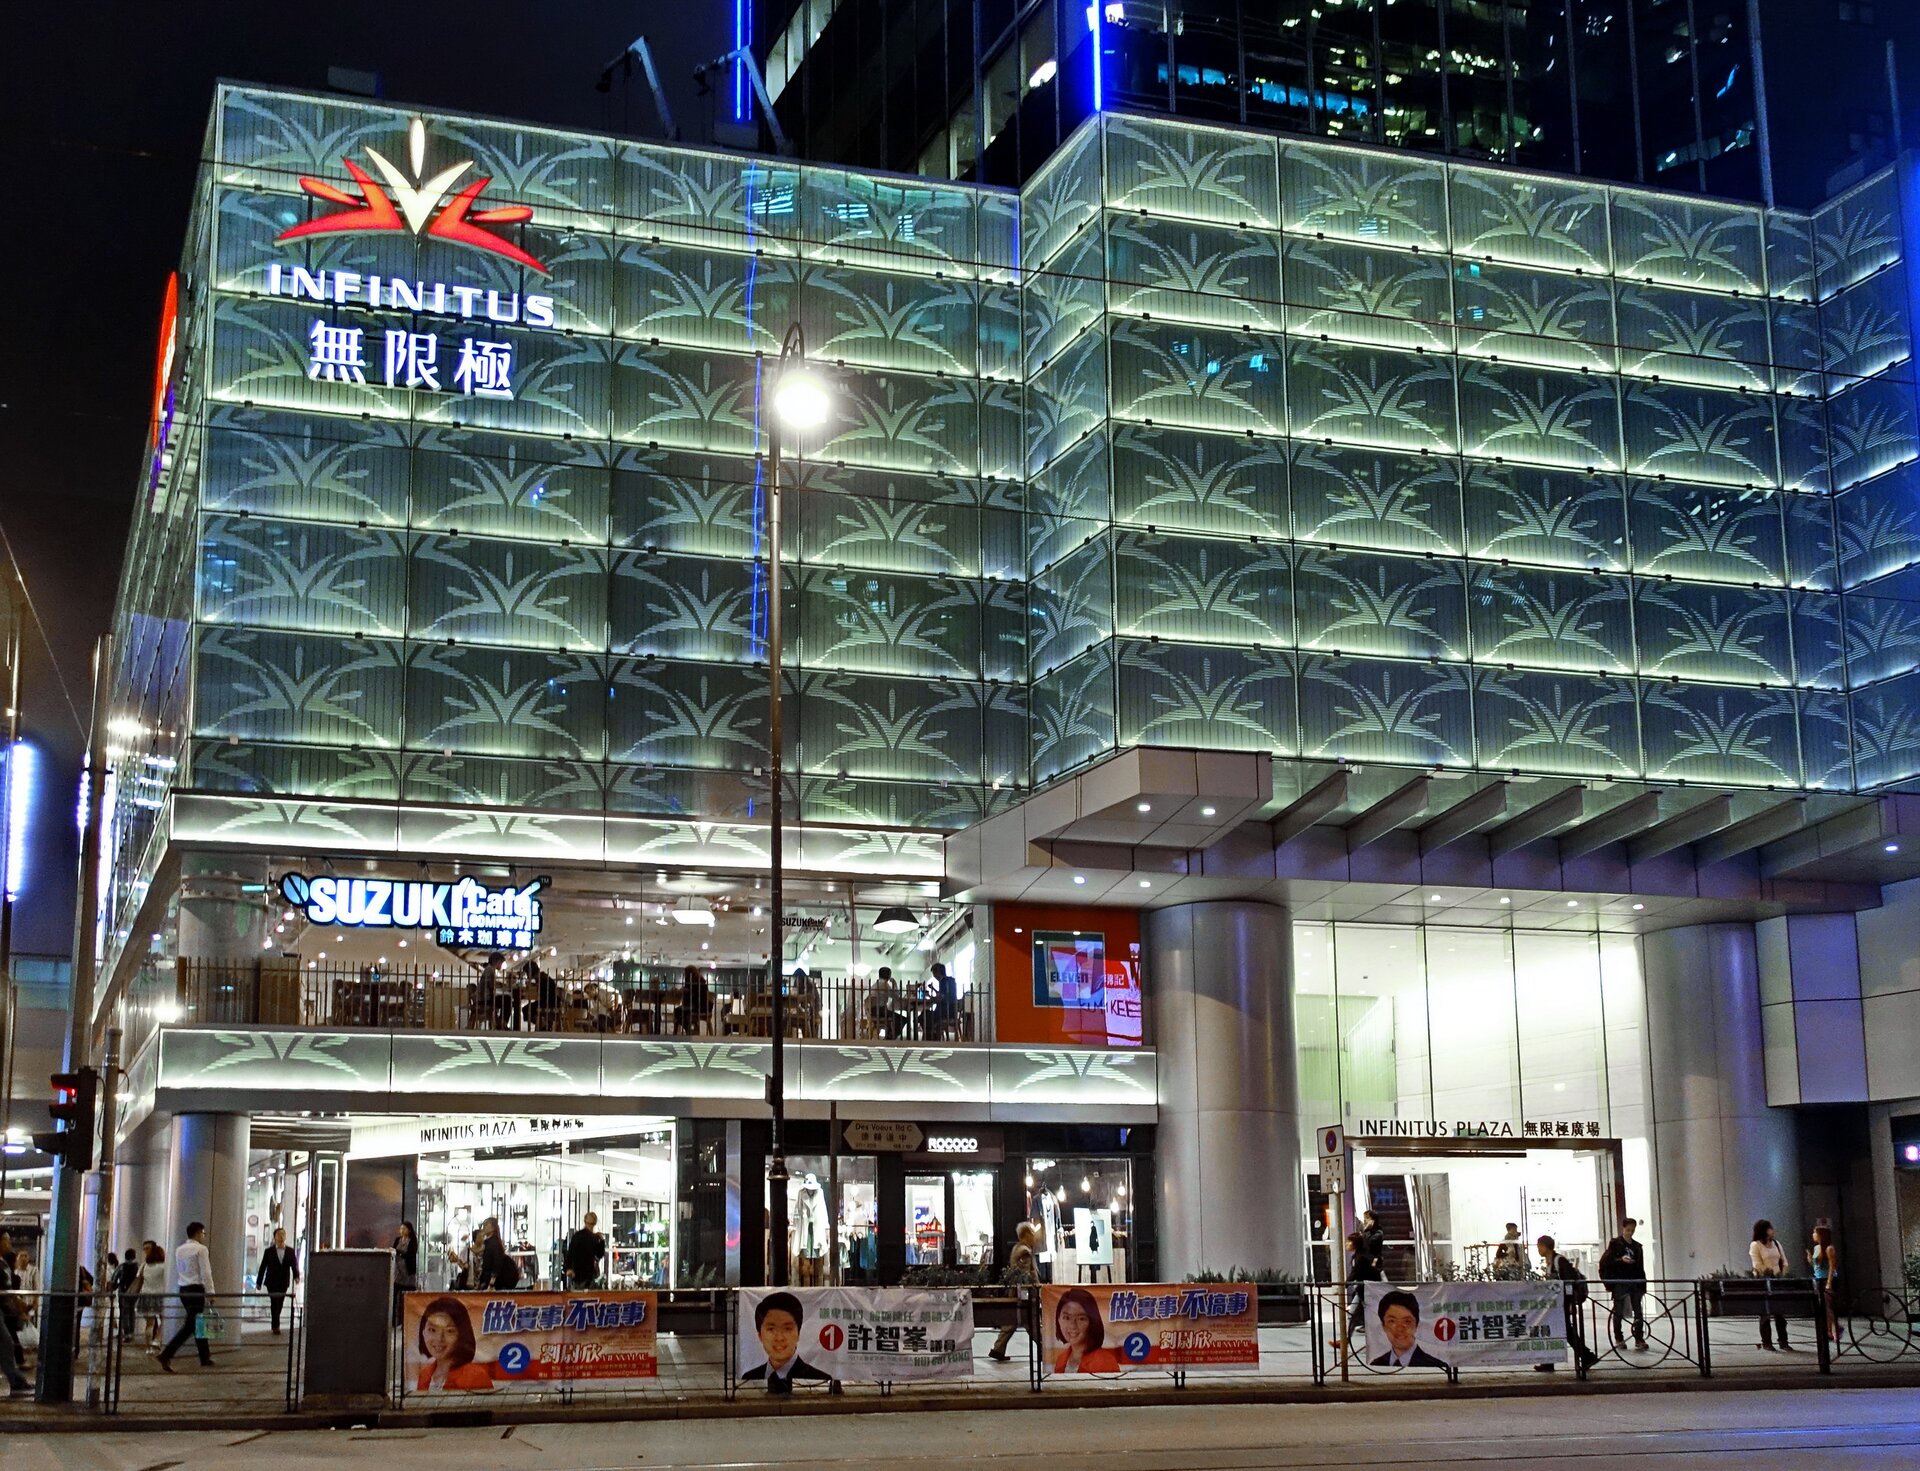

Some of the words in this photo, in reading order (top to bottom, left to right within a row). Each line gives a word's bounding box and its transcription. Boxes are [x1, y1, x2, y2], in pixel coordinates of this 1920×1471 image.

[268, 263, 555, 328] INFINITUS
[308, 320, 514, 401] 無限極
[309, 877, 463, 929] SUZUKI
[420, 1124, 474, 1143] INFINITUS
[479, 1121, 517, 1138] PLAZA
[855, 1123, 869, 1131] Des
[871, 1123, 893, 1132] Voeux
[895, 1123, 905, 1132] Rd
[1359, 1120, 1448, 1137] INFINITUS
[1456, 1121, 1514, 1138] PLAZA
[1523, 1120, 1602, 1138] 無限極廣場
[928, 1137, 978, 1150] ROCOCO
[506, 1346, 522, 1369] 2
[1130, 1336, 1144, 1357] 2
